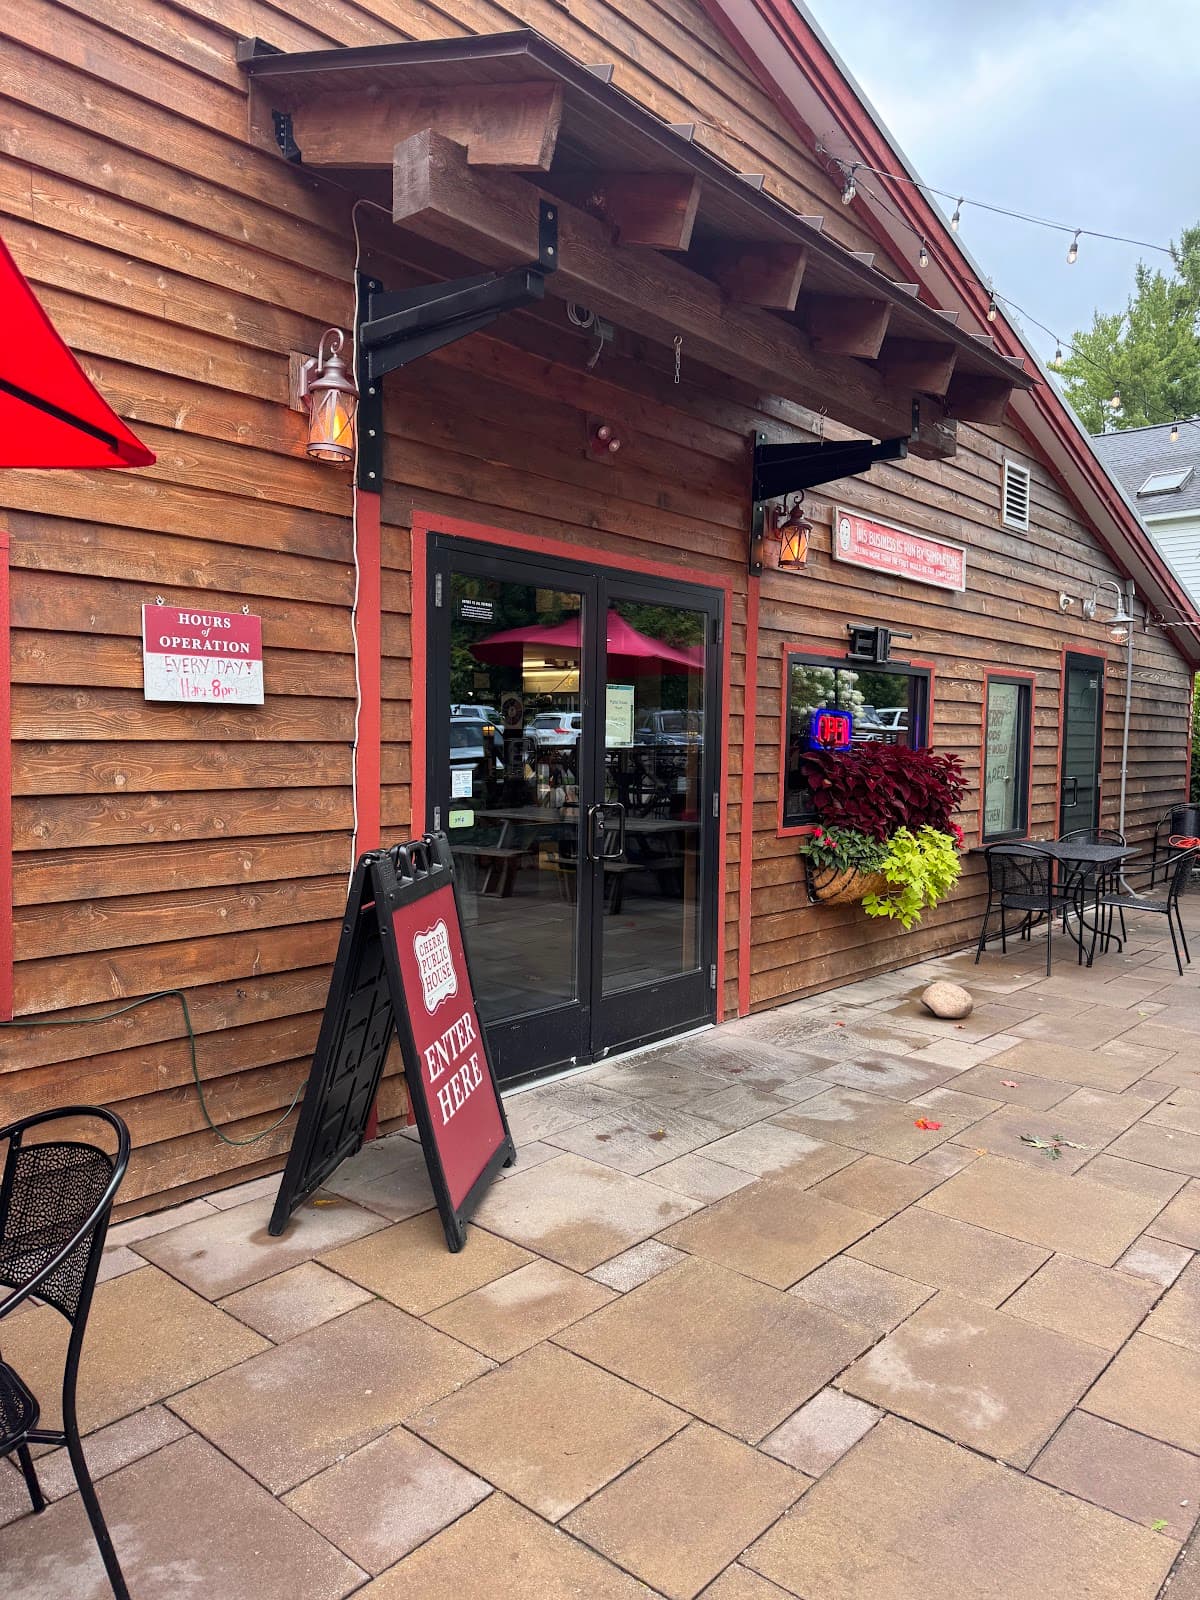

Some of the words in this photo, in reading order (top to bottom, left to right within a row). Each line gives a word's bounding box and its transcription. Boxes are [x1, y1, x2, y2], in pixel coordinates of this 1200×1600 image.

[856, 522, 868, 543] THIS
[868, 531, 897, 553] BUSINESS
[896, 539, 904, 554] IS
[904, 541, 916, 558] RUN
[916, 544, 925, 560] BY
[926, 548, 961, 571] SIMPLETONS
[178, 613, 231, 628] HOURS
[201, 628, 211, 637] of
[159, 636, 250, 653] OPERATION
[164, 656, 209, 674] EVERY
[217, 660, 253, 675] DAY!
[818, 715, 849, 744] OPEN
[419, 931, 447, 957] CHERRY
[421, 946, 449, 974] PUBLIC
[425, 962, 453, 993] HOUSE
[424, 1012, 476, 1083] ENTER
[437, 1052, 483, 1125] HERE
